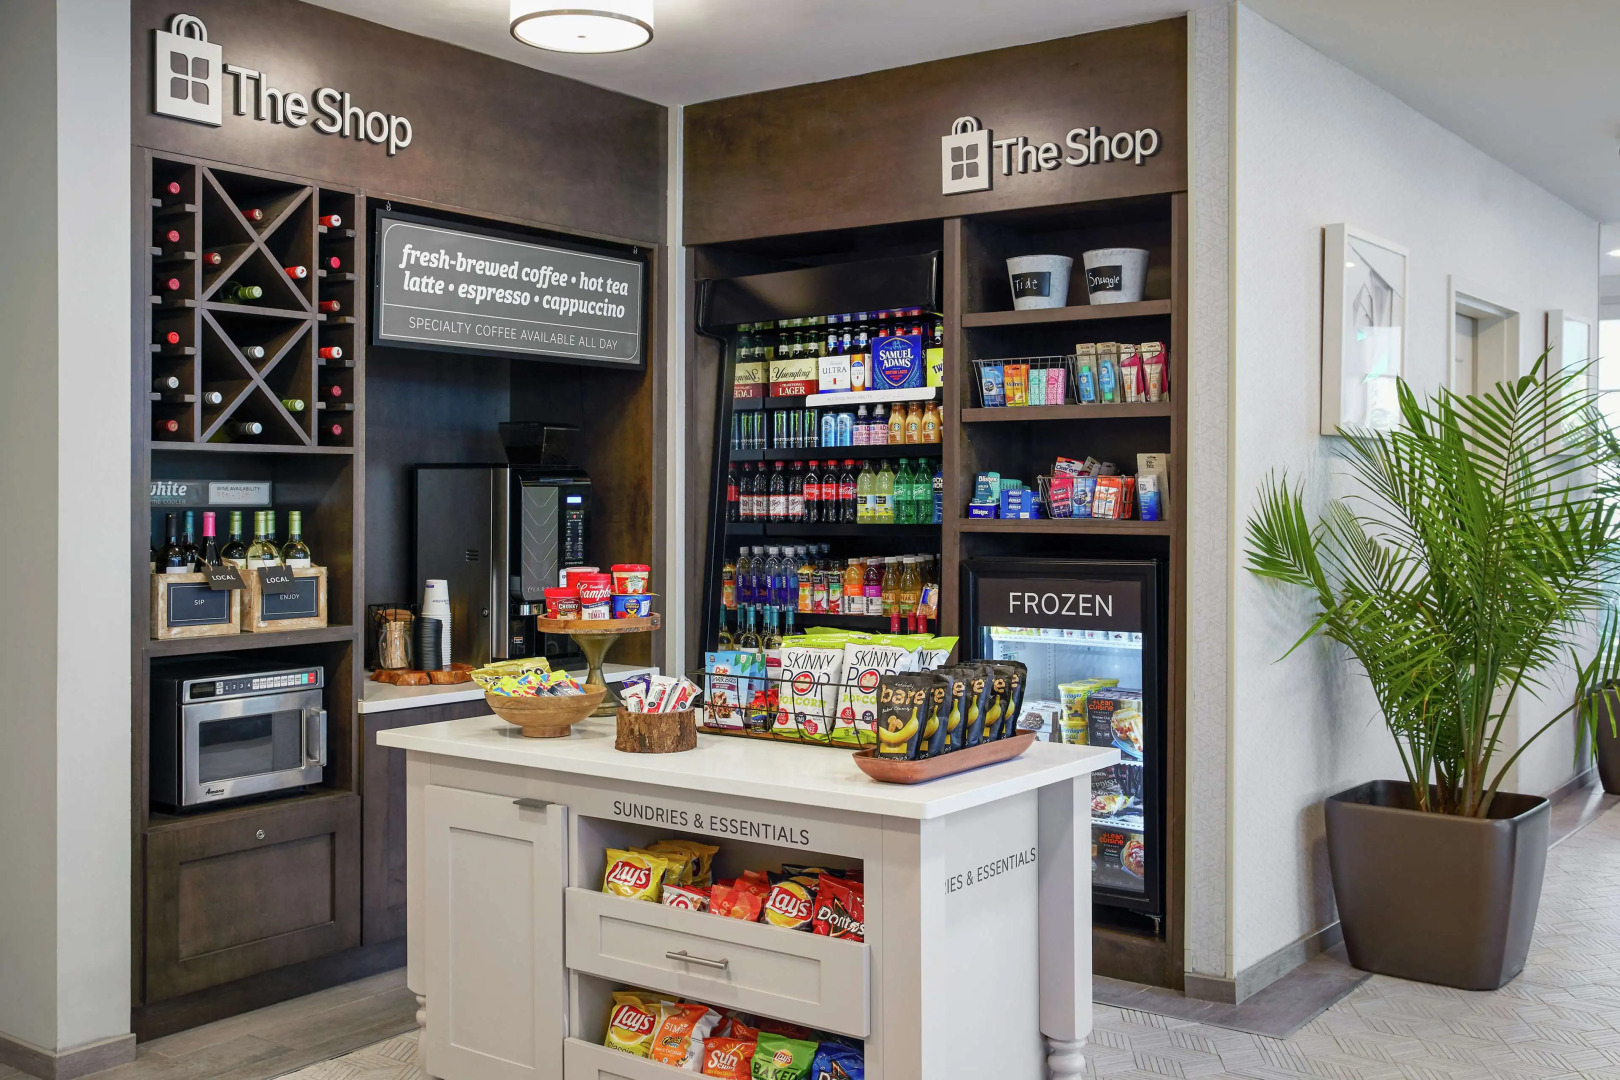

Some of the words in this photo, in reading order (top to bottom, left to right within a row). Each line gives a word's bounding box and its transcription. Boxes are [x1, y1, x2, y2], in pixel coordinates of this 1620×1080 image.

[224, 63, 308, 128] The
[314, 88, 412, 155] Shop
[993, 136, 1060, 175] The
[1066, 126, 1160, 166] Shop
[399, 244, 519, 280] fresh-brewed
[522, 266, 568, 288] coffee
[580, 272, 604, 292] hot
[606, 277, 628, 296] tea
[1089, 273, 1120, 288] Snuggle
[403, 271, 444, 294] latte
[458, 282, 530, 306] espresso
[542, 295, 625, 318] cappuccino
[1014, 278, 1038, 292] Tide
[408, 316, 472, 335] SPECIALTY
[475, 324, 517, 340] COFFEE
[520, 330, 576, 346] AVAILABLE
[578, 336, 596, 348] ALL
[600, 338, 618, 350] DAY
[880, 348, 914, 360] SAMUEL
[882, 358, 910, 369] ADAMS
[772, 366, 812, 382] Yuengling
[822, 366, 847, 374] ULTRA
[779, 386, 805, 395] LAGER
[1009, 592, 1113, 617] FROZEN
[784, 650, 836, 670] SKINNY
[851, 648, 904, 668] SKINNY
[780, 668, 831, 697] POP
[881, 684, 926, 705] bare
[614, 800, 688, 826] SUNDRIES
[694, 813, 704, 829] &
[710, 816, 809, 846] ESSENTIALS
[608, 862, 650, 887] Lay's
[945, 874, 963, 894] IES
[966, 871, 974, 886] &
[977, 847, 1036, 882] ESSENTIALS
[766, 887, 811, 918] Lay's
[817, 906, 864, 935] Doritos
[613, 1006, 655, 1032] Lay's
[708, 1050, 738, 1069] Sun
[774, 1051, 792, 1063] Lay's
